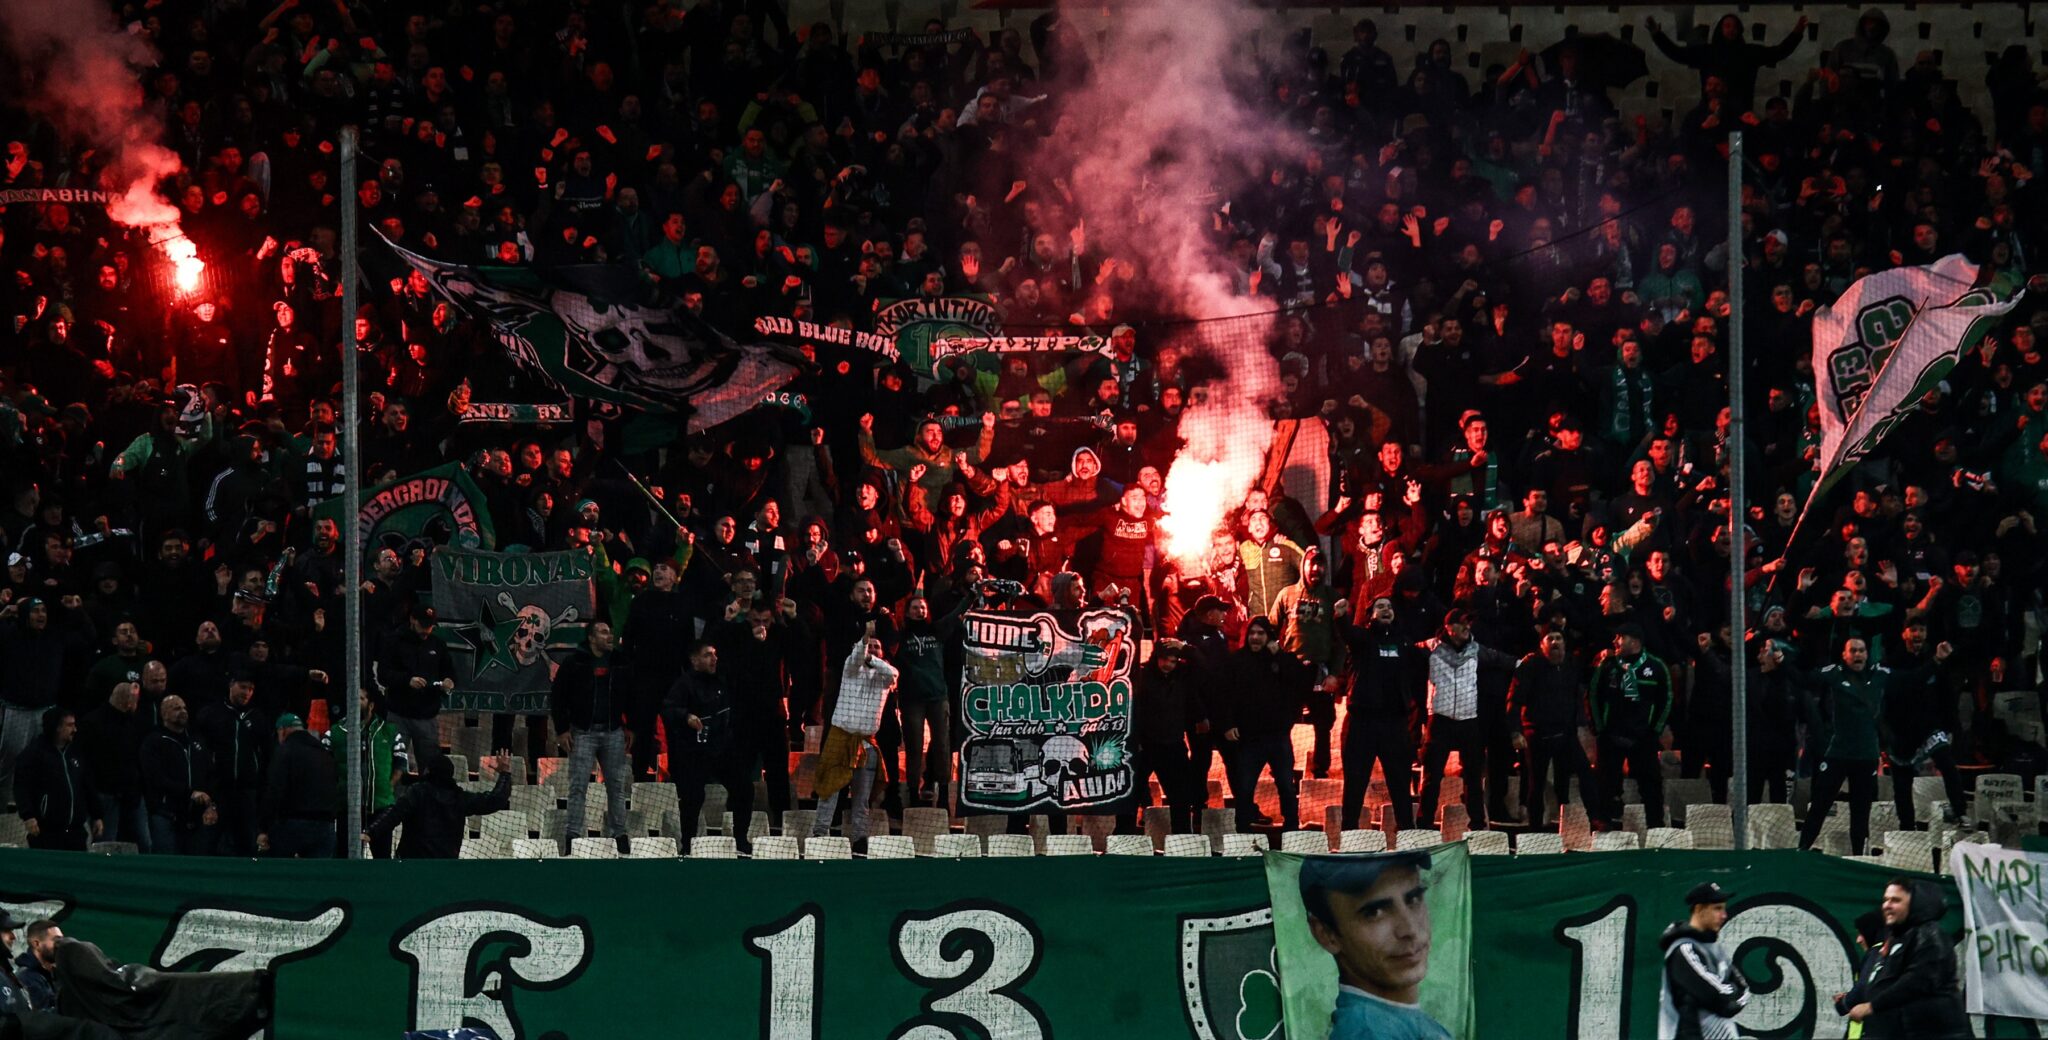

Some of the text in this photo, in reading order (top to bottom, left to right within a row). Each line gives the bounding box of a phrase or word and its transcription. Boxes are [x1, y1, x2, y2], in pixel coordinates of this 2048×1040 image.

[799, 321, 850, 346] BLUE
[438, 552, 593, 588] VIRONAS
[966, 619, 1037, 649] HOME
[988, 720, 1012, 739] fan
[1014, 720, 1046, 736] club
[1079, 721, 1110, 737] gate
[1063, 769, 1127, 802] AWAY
